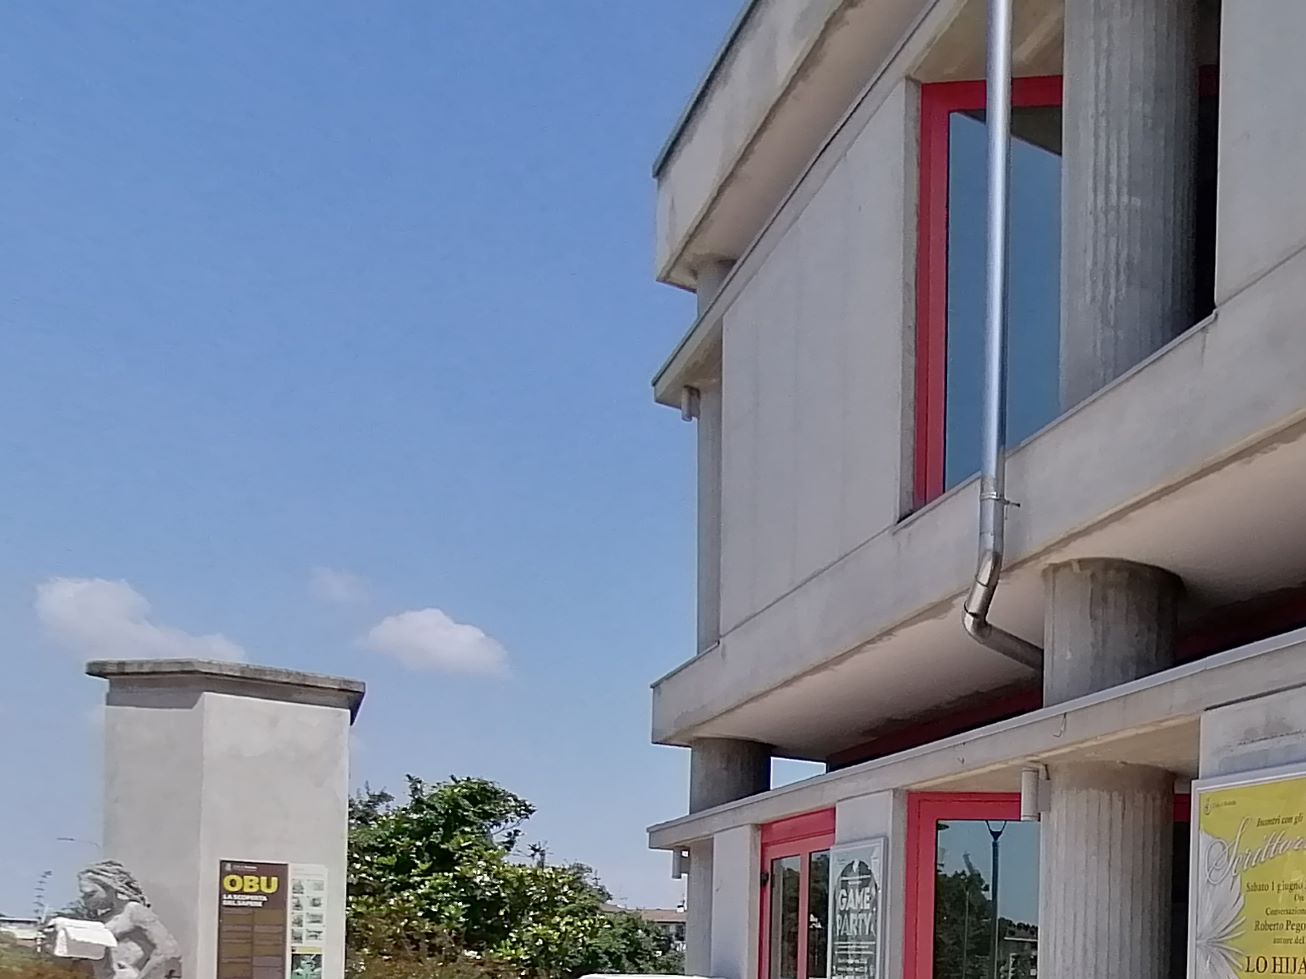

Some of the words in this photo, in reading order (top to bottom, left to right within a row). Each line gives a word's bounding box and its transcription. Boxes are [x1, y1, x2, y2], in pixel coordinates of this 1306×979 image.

[223, 874, 278, 893] OBU
[1246, 881, 1269, 892] Sabato
[1277, 881, 1304, 893] giugno
[838, 887, 870, 912] GAME
[836, 913, 872, 936] PARTY
[1254, 920, 1284, 932] Roberto
[1245, 956, 1268, 974] LO
